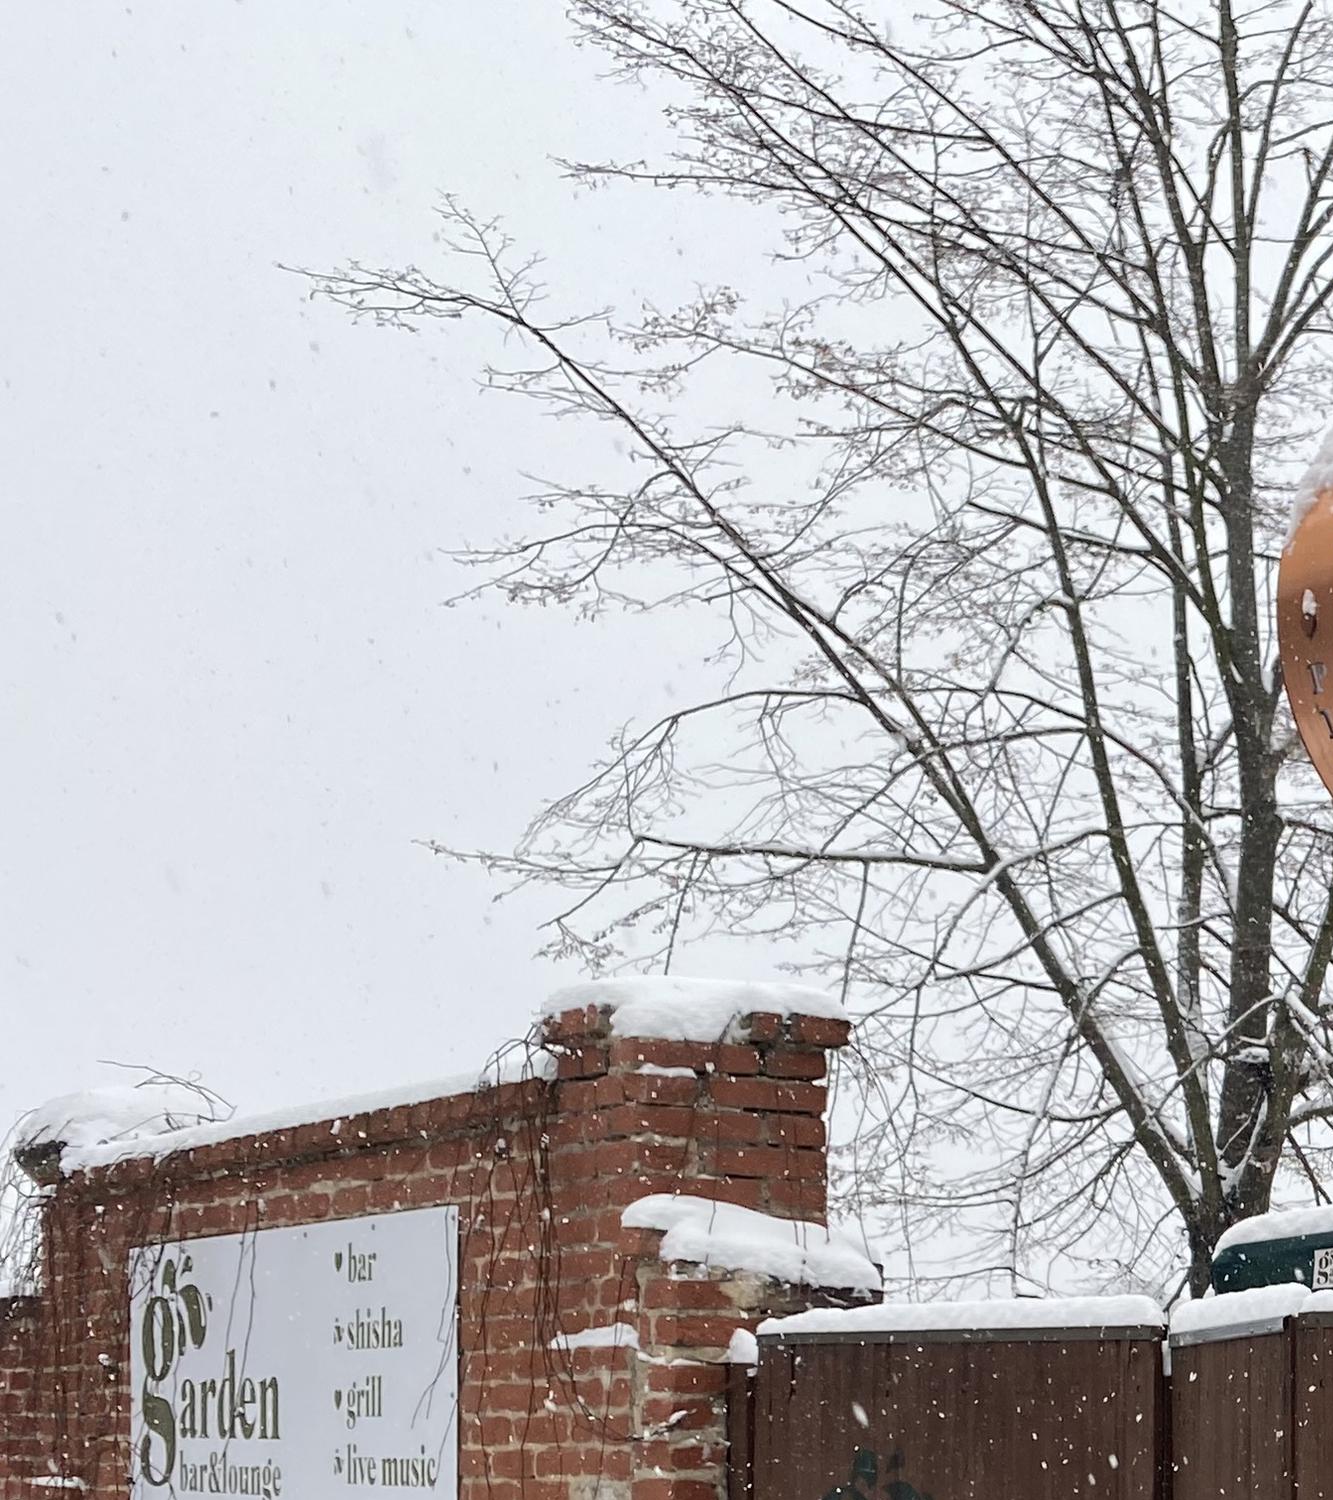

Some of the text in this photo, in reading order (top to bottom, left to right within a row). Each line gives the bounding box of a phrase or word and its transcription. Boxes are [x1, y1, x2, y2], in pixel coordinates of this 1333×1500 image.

[347, 1241, 377, 1283] bar
[346, 1307, 403, 1351] shisha
[140, 1290, 282, 1487] garden
[346, 1375, 382, 1430] grill
[346, 1444, 437, 1490] live music
